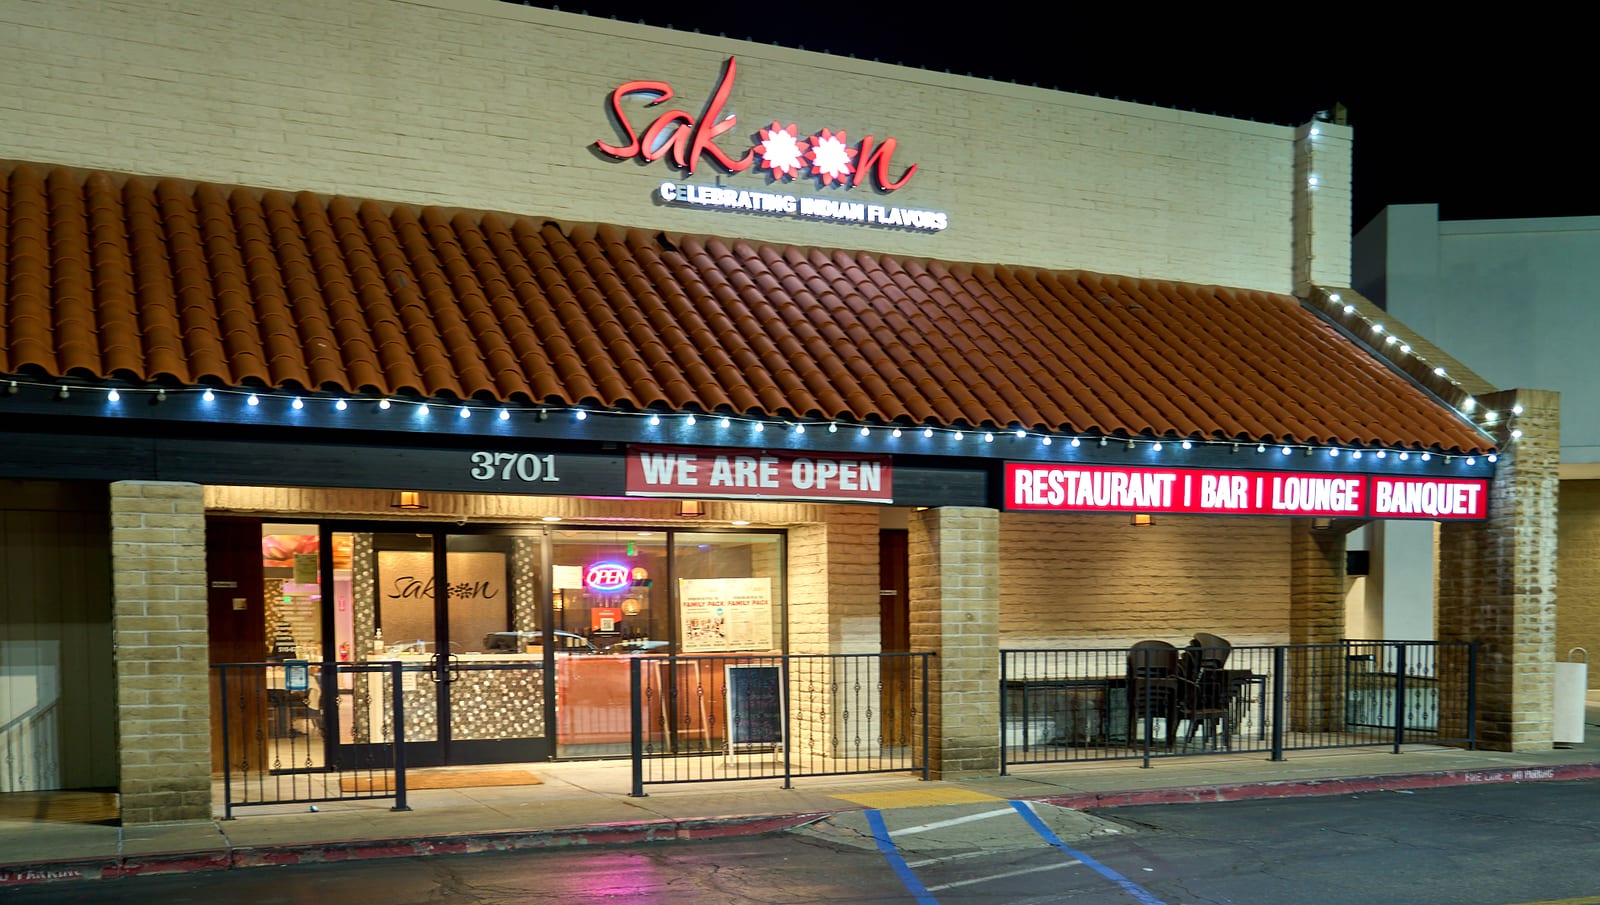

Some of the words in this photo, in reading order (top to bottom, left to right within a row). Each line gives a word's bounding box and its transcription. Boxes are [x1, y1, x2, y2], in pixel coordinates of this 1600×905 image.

[660, 182, 796, 213] CELEBRATING
[800, 197, 864, 221] INDIAN
[867, 205, 948, 230] FLAVORS
[470, 451, 560, 482] 3701
[640, 452, 698, 485] WE
[709, 455, 779, 488] ARE
[791, 459, 881, 491] OPEN
[1015, 469, 1176, 508] RESTAURANT
[1200, 474, 1249, 509] BAR
[1271, 477, 1360, 512] LOUNGE
[1375, 481, 1481, 517] BANQUET
[586, 569, 629, 586] OPEN
